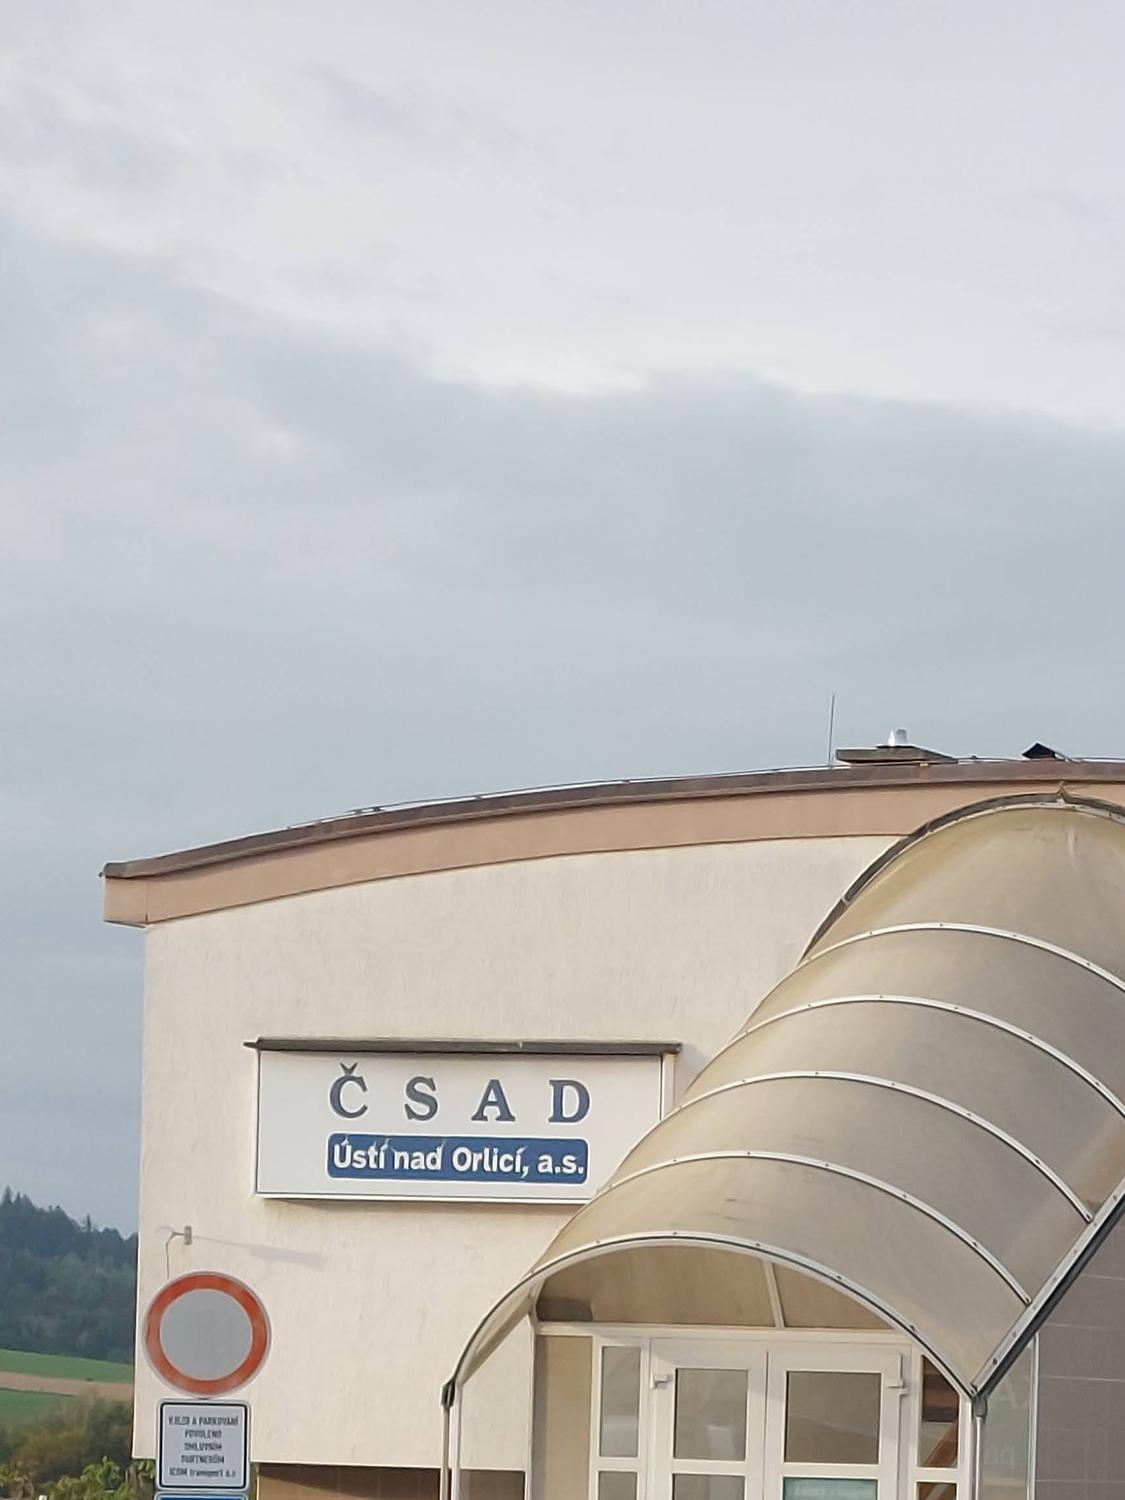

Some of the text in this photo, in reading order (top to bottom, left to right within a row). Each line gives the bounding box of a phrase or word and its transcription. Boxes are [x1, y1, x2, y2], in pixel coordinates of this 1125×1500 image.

[333, 1137, 585, 1177] Ústí nad Orlicí, a.s.
